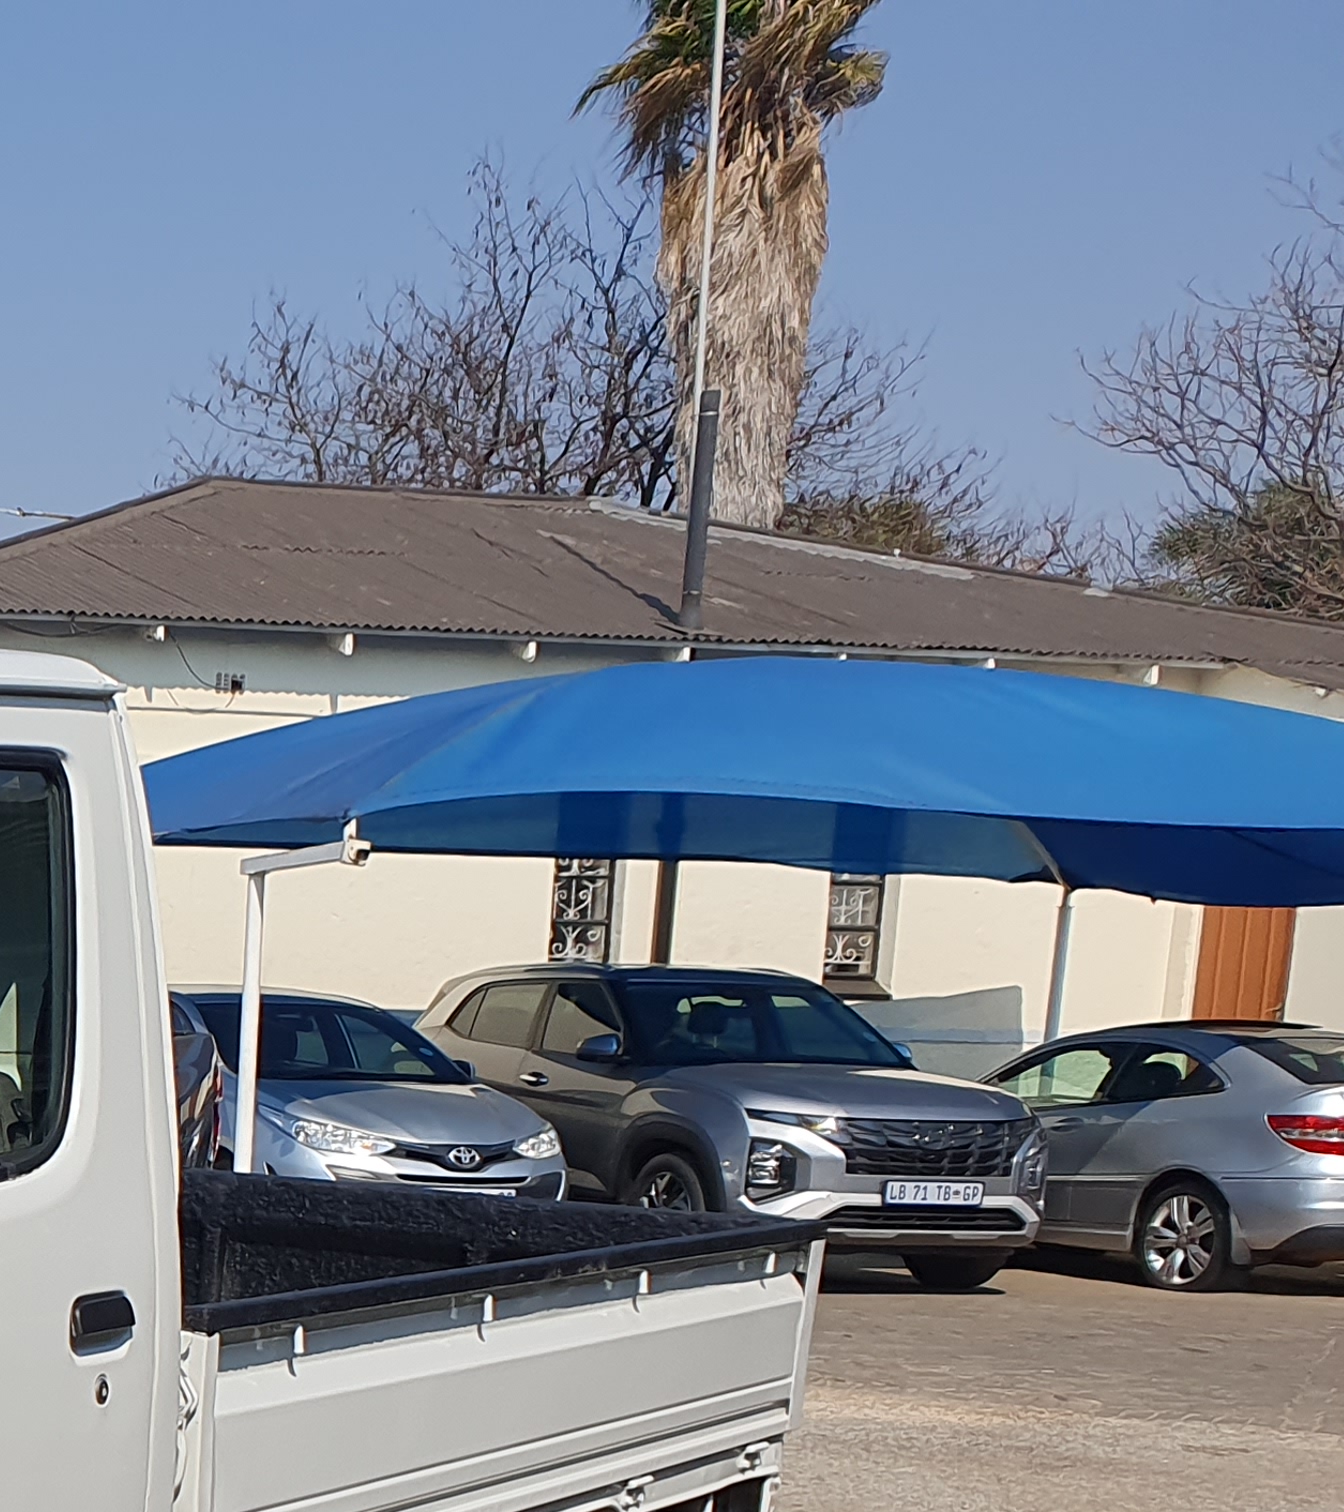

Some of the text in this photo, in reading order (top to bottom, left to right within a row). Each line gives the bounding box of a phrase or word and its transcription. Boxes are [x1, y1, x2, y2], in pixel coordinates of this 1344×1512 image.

[889, 1184, 980, 1202] LB 71 TB GP
